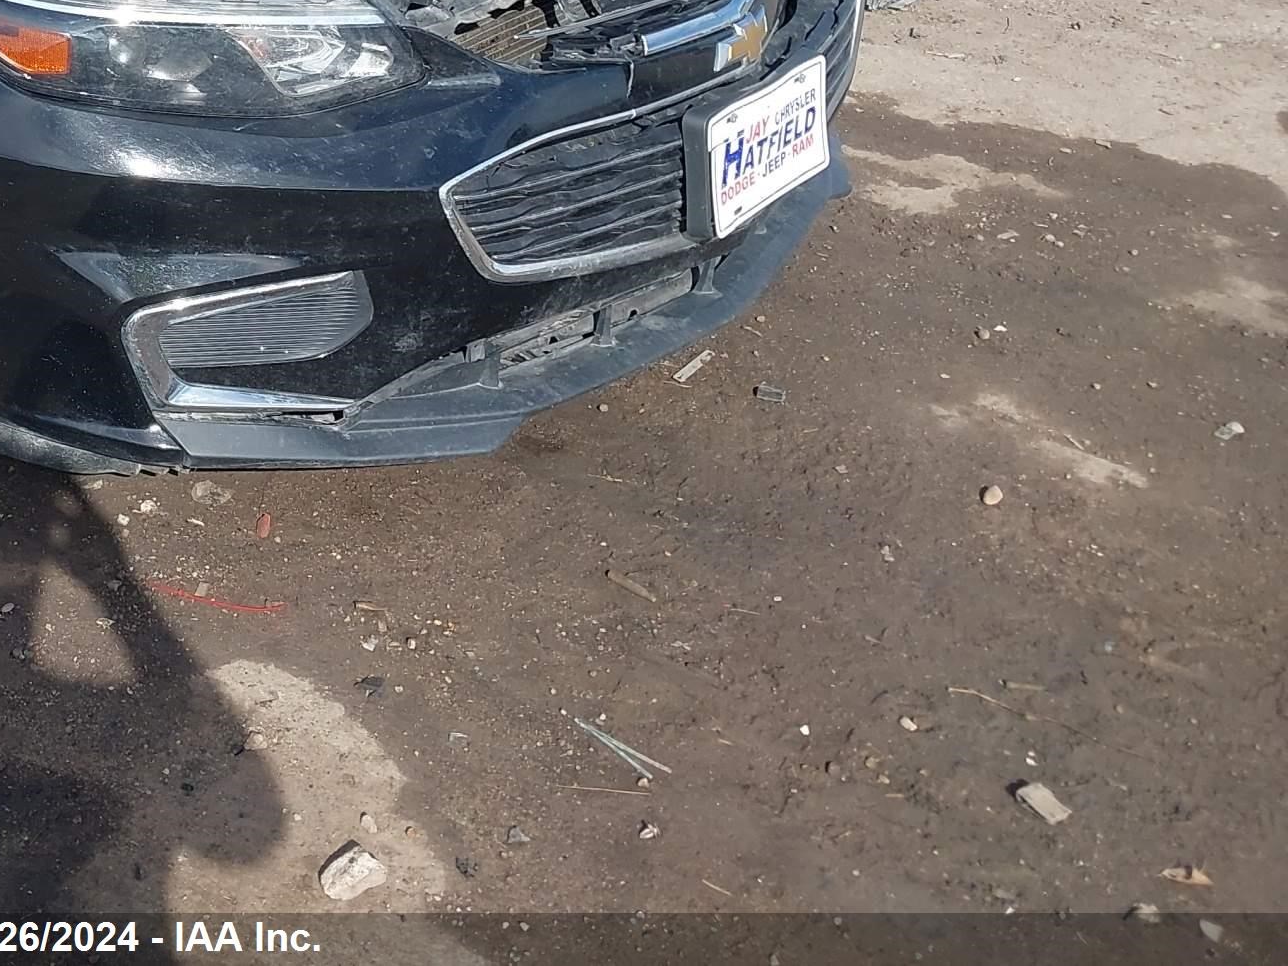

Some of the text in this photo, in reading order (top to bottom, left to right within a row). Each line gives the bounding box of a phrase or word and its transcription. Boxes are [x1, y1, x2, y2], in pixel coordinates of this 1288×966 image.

[721, 106, 816, 190] HATFIELD
[746, 88, 816, 144] JAY CHRYSLER
[721, 134, 814, 205] DODGE JEEP RAM
